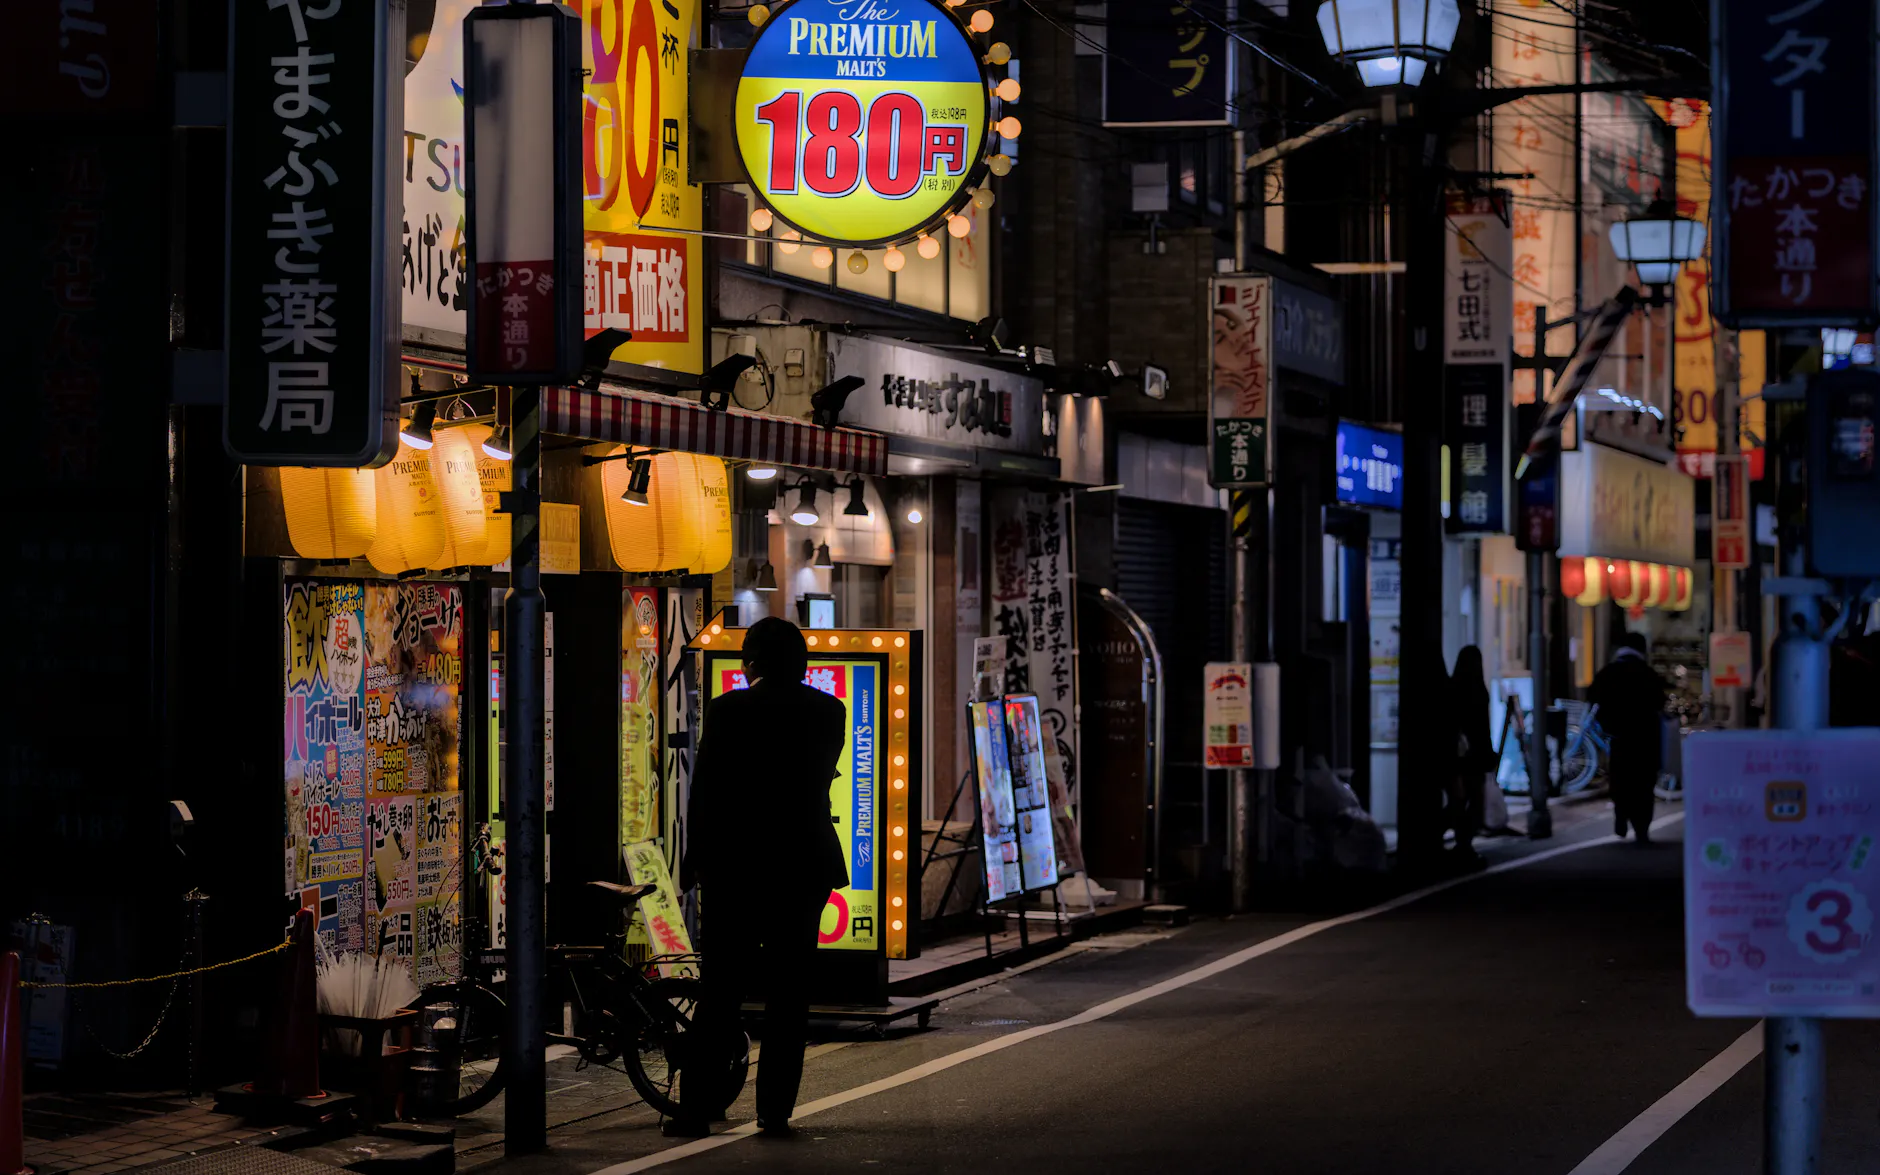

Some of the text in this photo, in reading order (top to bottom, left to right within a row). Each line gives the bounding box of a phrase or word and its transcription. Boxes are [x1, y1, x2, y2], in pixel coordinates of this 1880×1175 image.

[787, 17, 938, 59] PREMIUM
[1167, 0, 1211, 98] ップ
[836, 57, 886, 77] MALT'S
[754, 88, 969, 200] 180円
[1729, 164, 1868, 214] たかつき
[1773, 204, 1820, 305] 本通り
[475, 266, 556, 300] たかつき
[502, 293, 529, 370] 本通り
[1230, 434, 1249, 482] 本通り
[426, 652, 462, 686] 480円
[285, 694, 364, 763] ハイボール
[853, 724, 872, 774] MALT'S
[306, 804, 341, 838] 150円
[856, 777, 872, 837] PREMIUM
[1740, 834, 1855, 853] ポイントアップ
[1742, 855, 1845, 873] キャンペーン
[387, 879, 410, 900] 550円
[1805, 889, 1854, 955] 3
